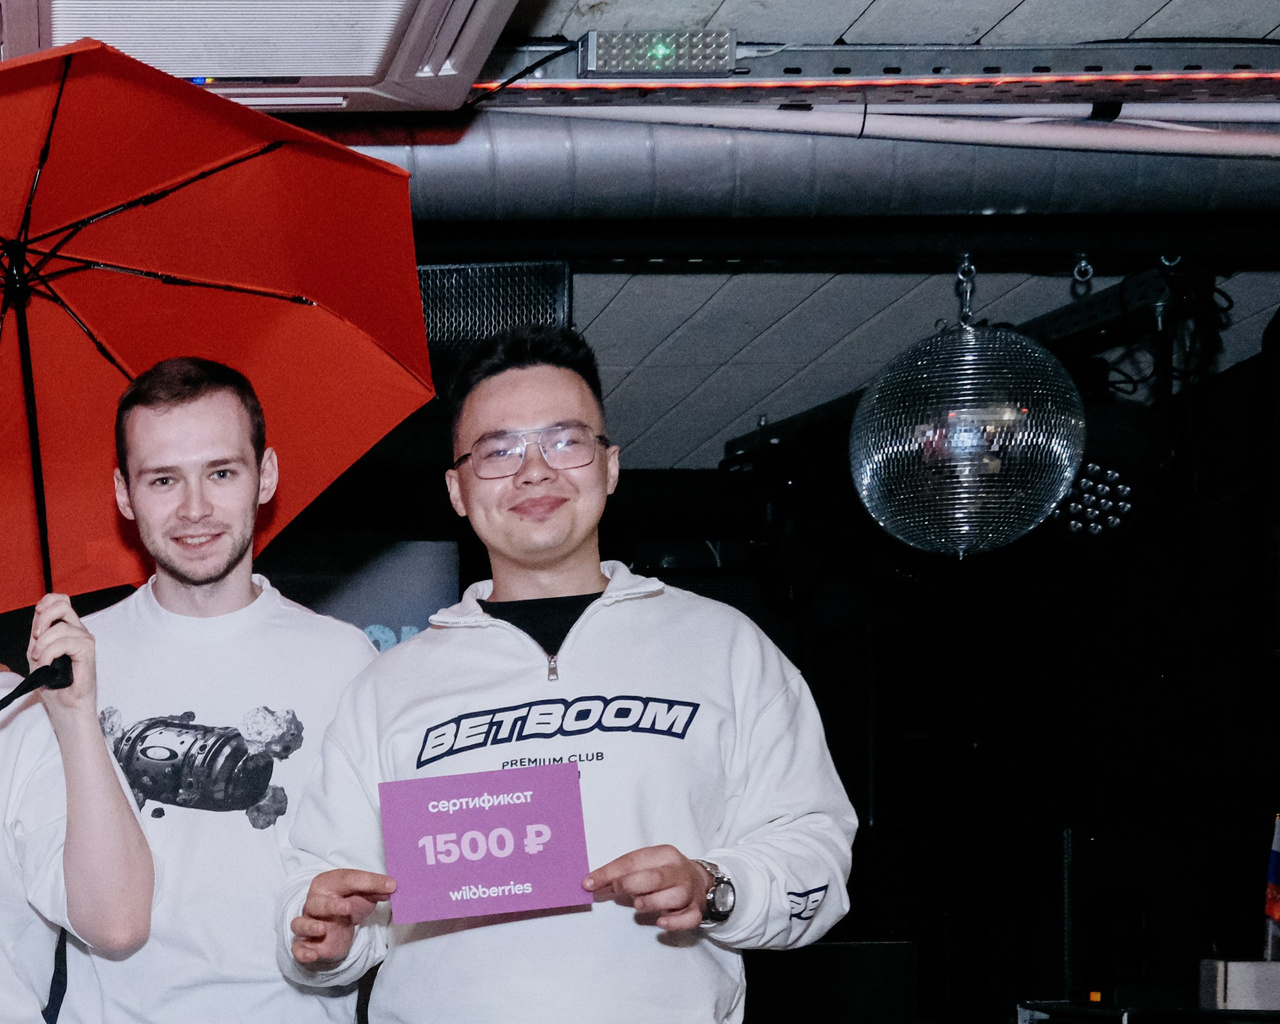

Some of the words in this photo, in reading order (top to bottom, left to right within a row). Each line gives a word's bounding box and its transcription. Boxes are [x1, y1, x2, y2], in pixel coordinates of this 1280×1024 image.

[416, 695, 700, 770] BETBOOM
[567, 751, 604, 763] CLUB
[428, 791, 533, 814] сертификат
[418, 827, 514, 865] 1500
[449, 880, 533, 901] wildberries
